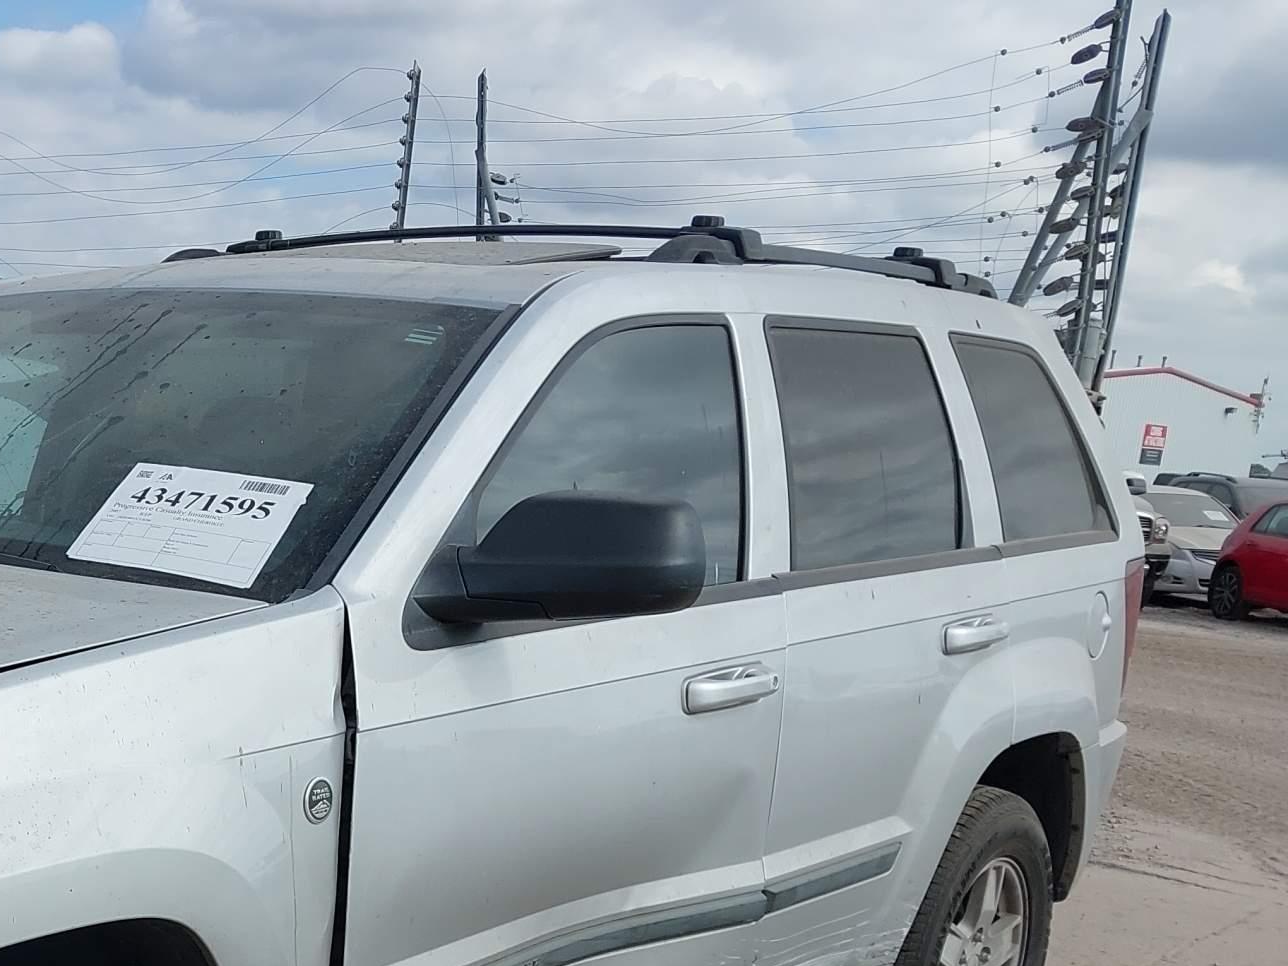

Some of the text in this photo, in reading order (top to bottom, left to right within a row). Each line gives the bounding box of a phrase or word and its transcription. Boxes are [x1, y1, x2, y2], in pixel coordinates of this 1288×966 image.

[113, 502, 224, 521] Progressive Casualty Insurance
[131, 486, 276, 520] 43471595
